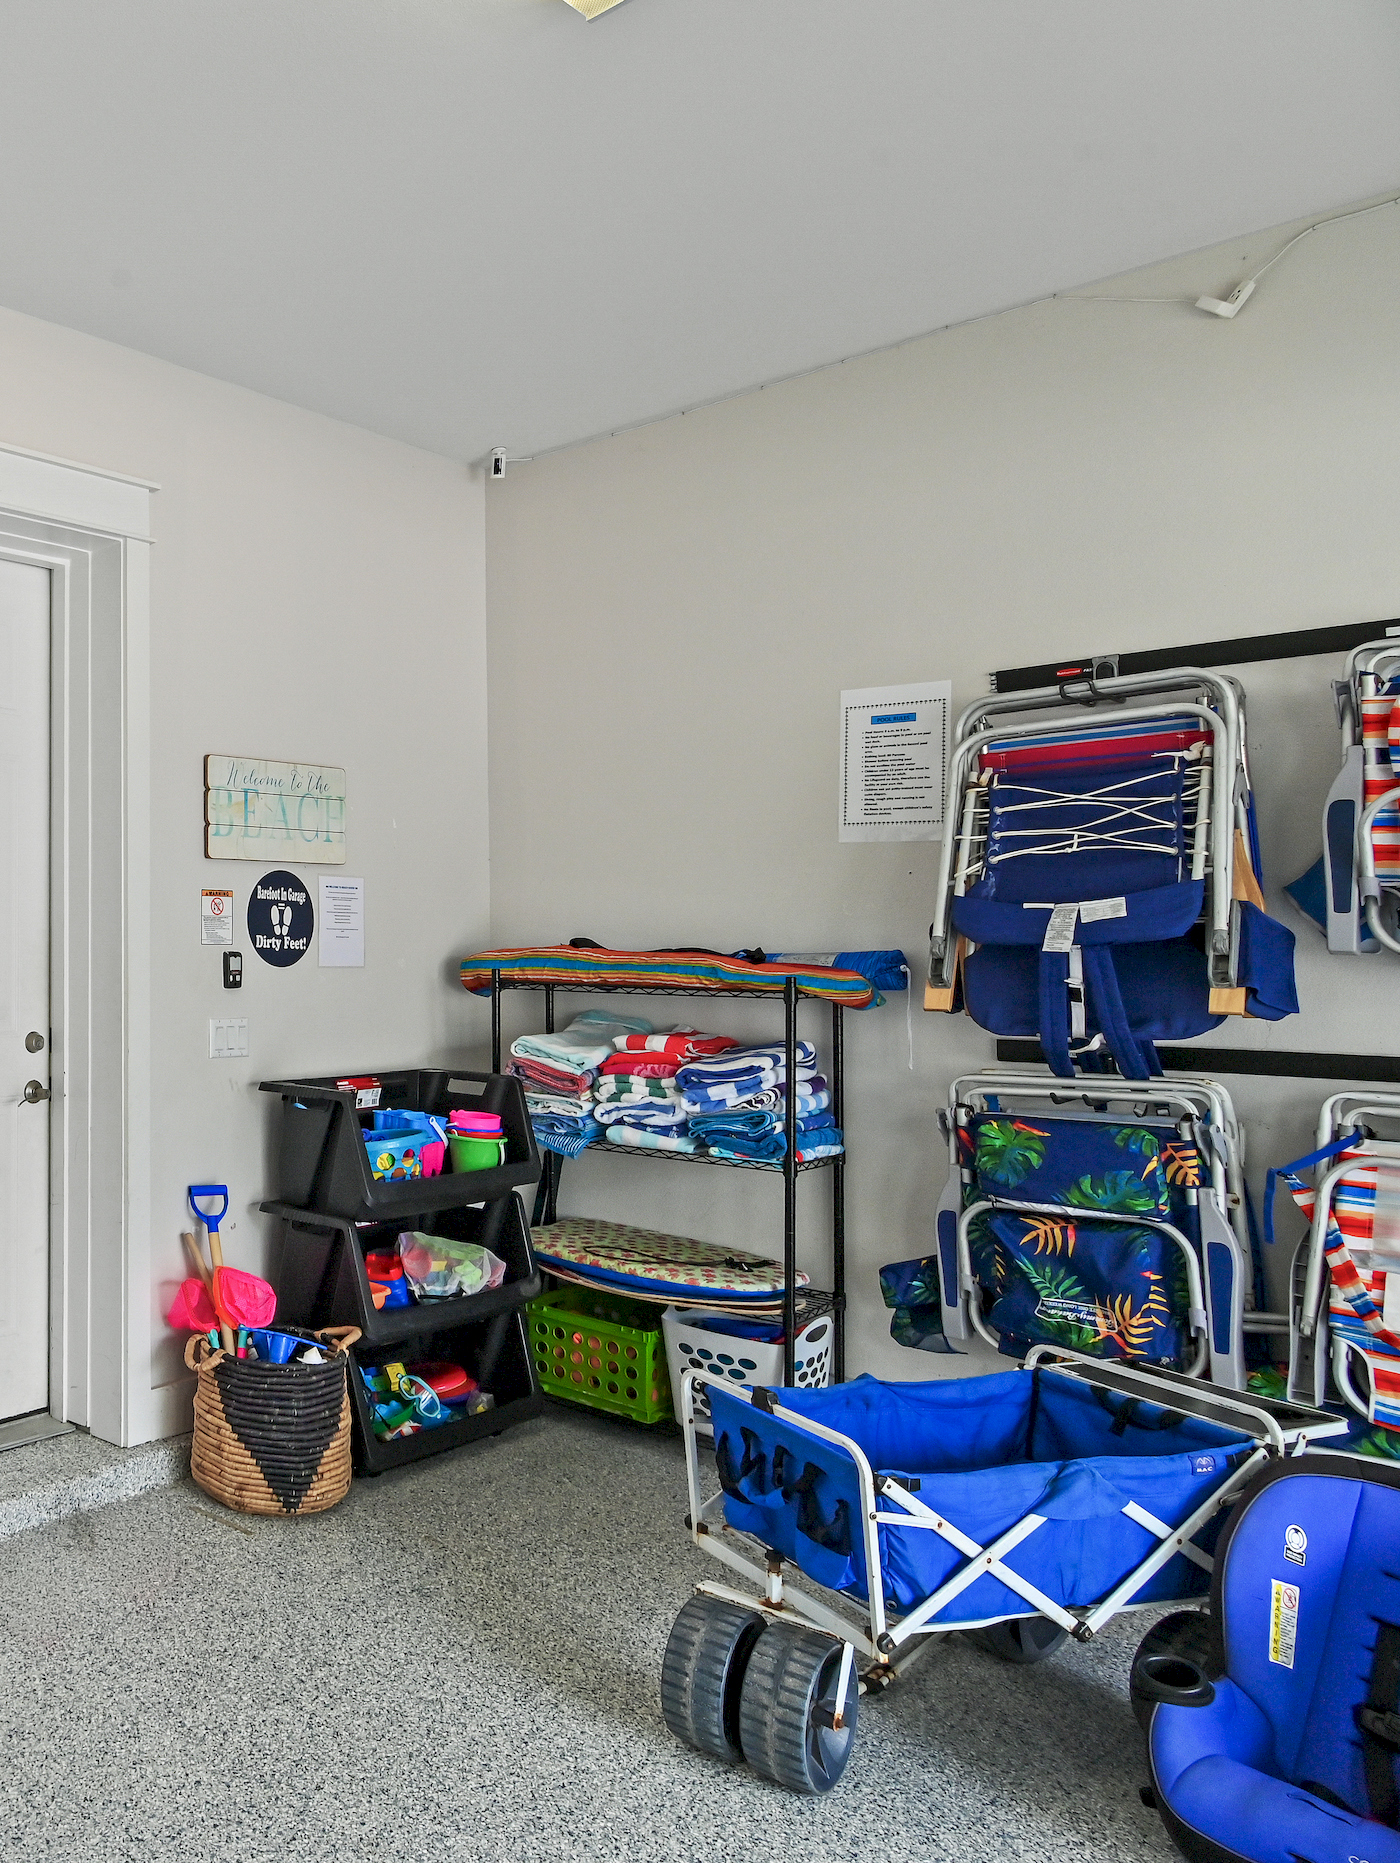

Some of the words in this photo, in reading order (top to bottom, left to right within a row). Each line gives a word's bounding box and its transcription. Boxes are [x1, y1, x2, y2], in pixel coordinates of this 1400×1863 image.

[227, 760, 285, 789] Welcome
[210, 786, 345, 843] BEACH
[257, 885, 280, 900] Barefoot
[281, 887, 287, 900] In
[288, 888, 306, 905] Garage
[256, 935, 282, 951] Dirty
[284, 936, 306, 950] Feet!
